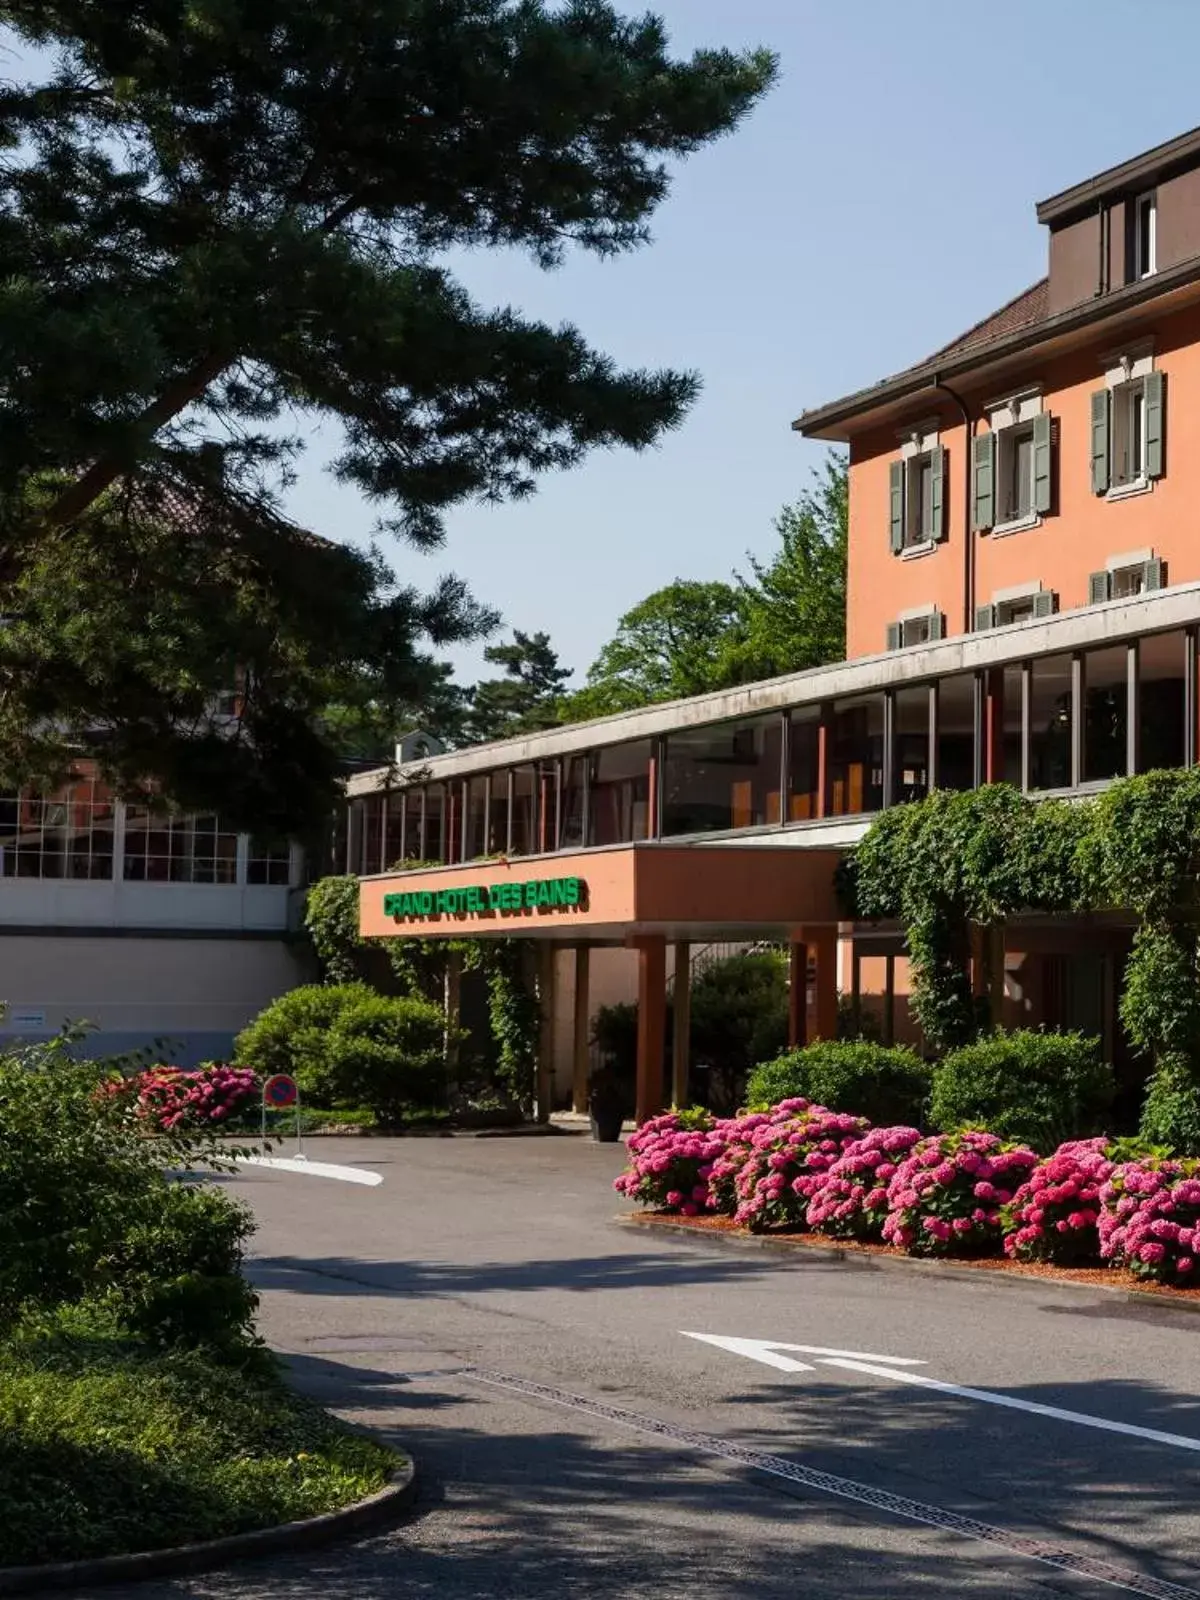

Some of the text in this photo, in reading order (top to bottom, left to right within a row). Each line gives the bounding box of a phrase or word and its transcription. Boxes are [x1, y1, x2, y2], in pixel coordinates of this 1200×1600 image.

[384, 877, 579, 917] GRAND HOTEL DES BAINS
